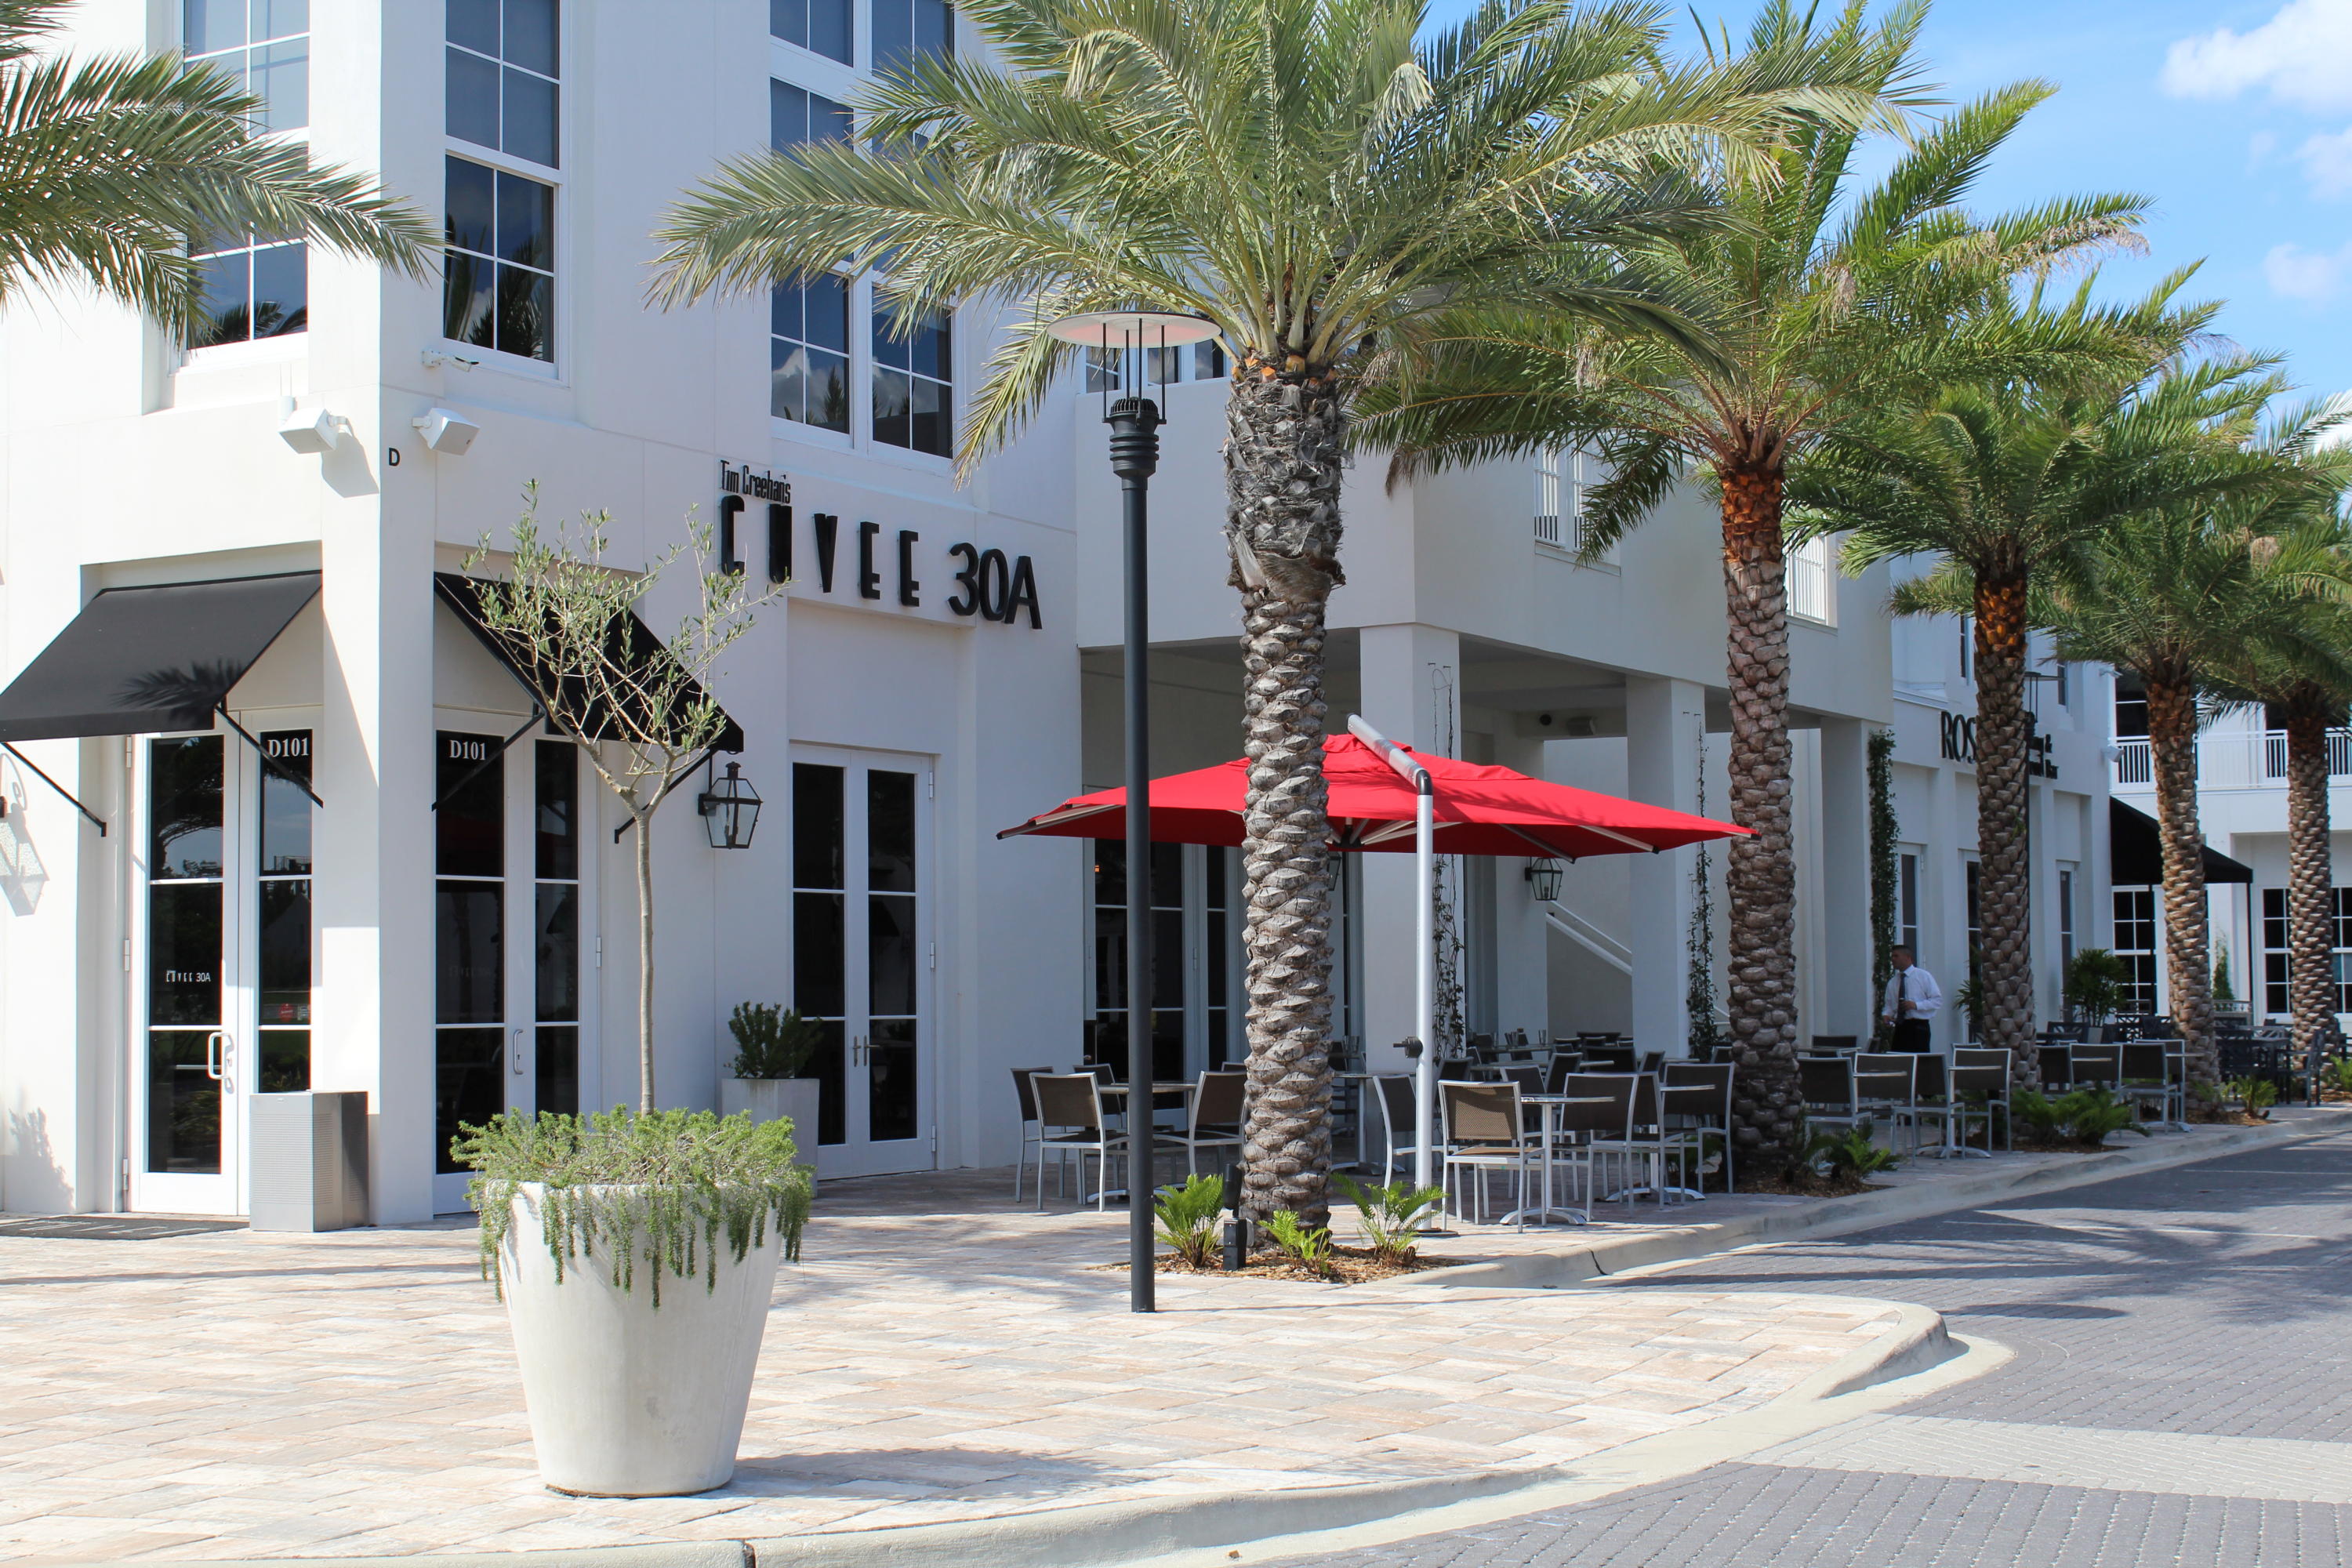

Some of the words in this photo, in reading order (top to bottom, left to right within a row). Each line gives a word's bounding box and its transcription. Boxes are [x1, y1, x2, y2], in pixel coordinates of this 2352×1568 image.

[389, 448, 401, 466] D
[720, 459, 739, 493] Tim
[742, 465, 791, 504] Creehan's
[720, 495, 920, 607] CUVEE
[948, 542, 1043, 630] 30A
[267, 738, 309, 757] D101
[449, 739, 486, 760] D101
[196, 972, 211, 982] 30A
